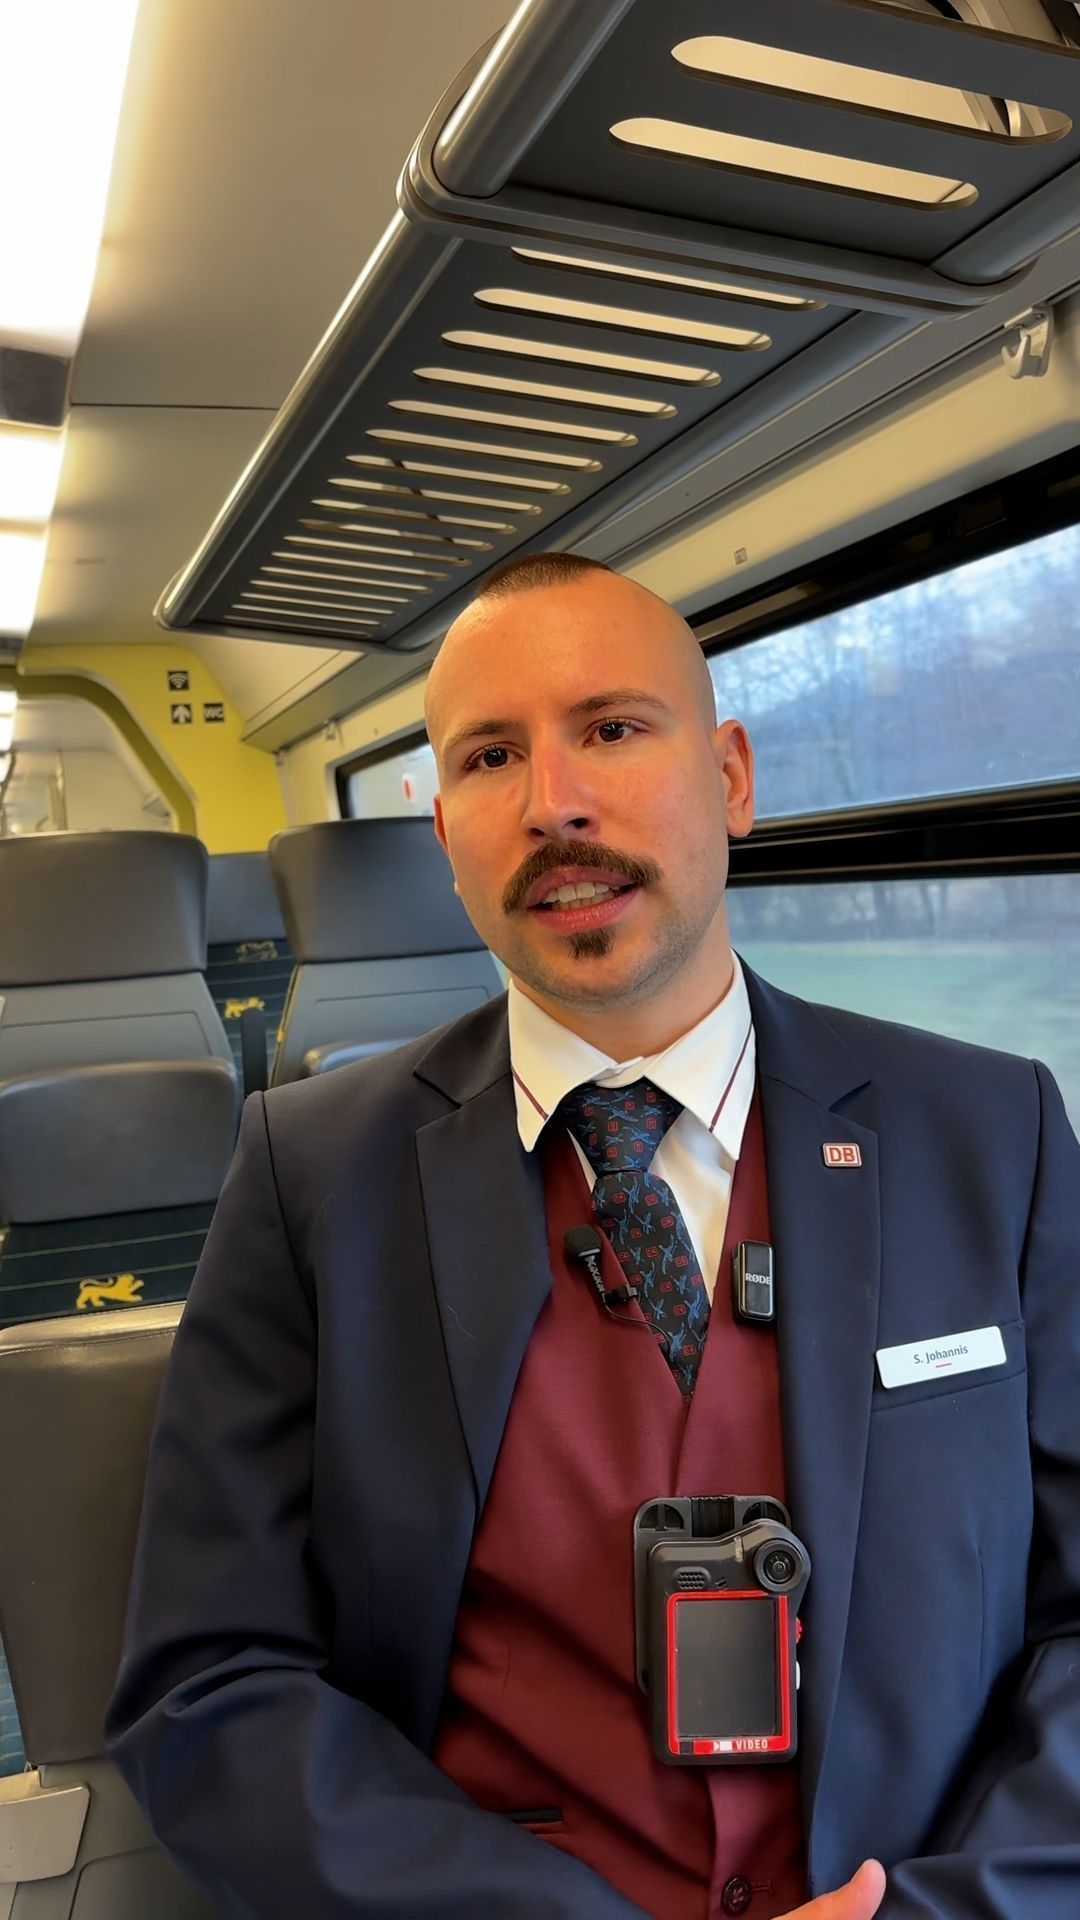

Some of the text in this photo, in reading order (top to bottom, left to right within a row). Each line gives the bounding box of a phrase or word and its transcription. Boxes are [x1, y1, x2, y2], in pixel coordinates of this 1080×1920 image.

[204, 706, 224, 719] WC
[829, 1147, 855, 1162] DB
[913, 1345, 968, 1364] S. Johannis
[735, 1739, 768, 1751] VIDEO
